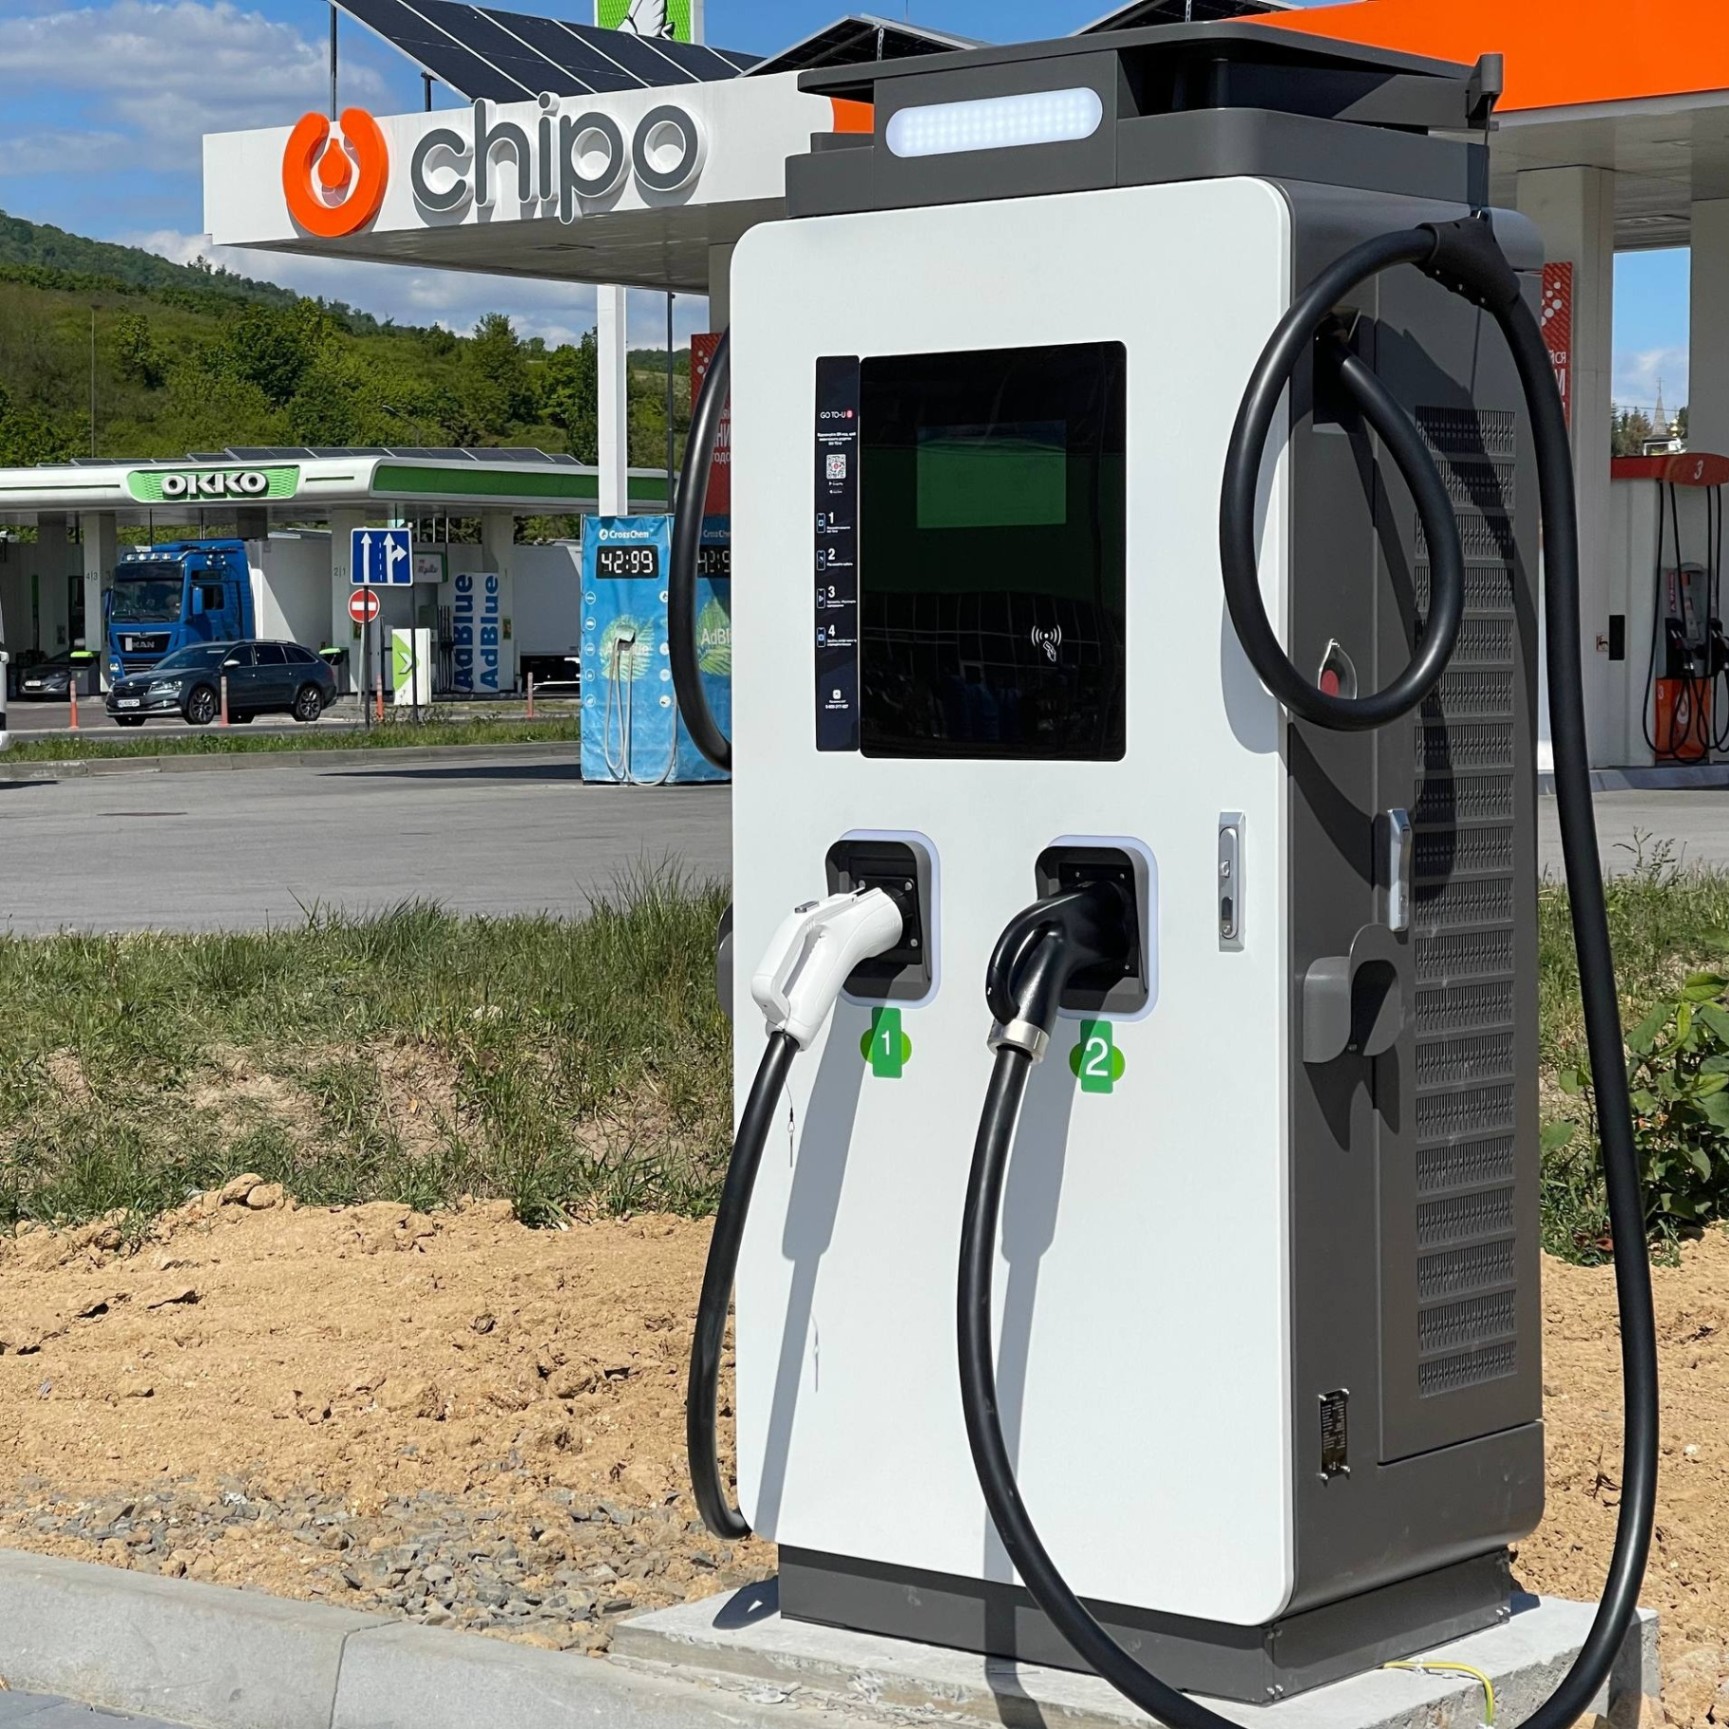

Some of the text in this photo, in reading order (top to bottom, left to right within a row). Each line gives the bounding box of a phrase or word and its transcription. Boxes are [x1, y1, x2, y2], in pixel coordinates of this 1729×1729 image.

[410, 92, 706, 225] chipo
[819, 411, 831, 419] GO
[1694, 459, 1704, 480] 3
[161, 472, 267, 496] OKKO
[828, 511, 834, 524] 1
[608, 529, 649, 539] CrossChem
[601, 550, 654, 574] 42:99
[828, 548, 836, 560] 2
[828, 585, 836, 598] 3
[453, 574, 474, 690] AdBlue
[480, 575, 499, 689] AdBlue
[701, 628, 730, 646] AdBl
[828, 624, 836, 637] 4
[880, 1030, 892, 1056] 1
[1084, 1037, 1109, 1078] 2
